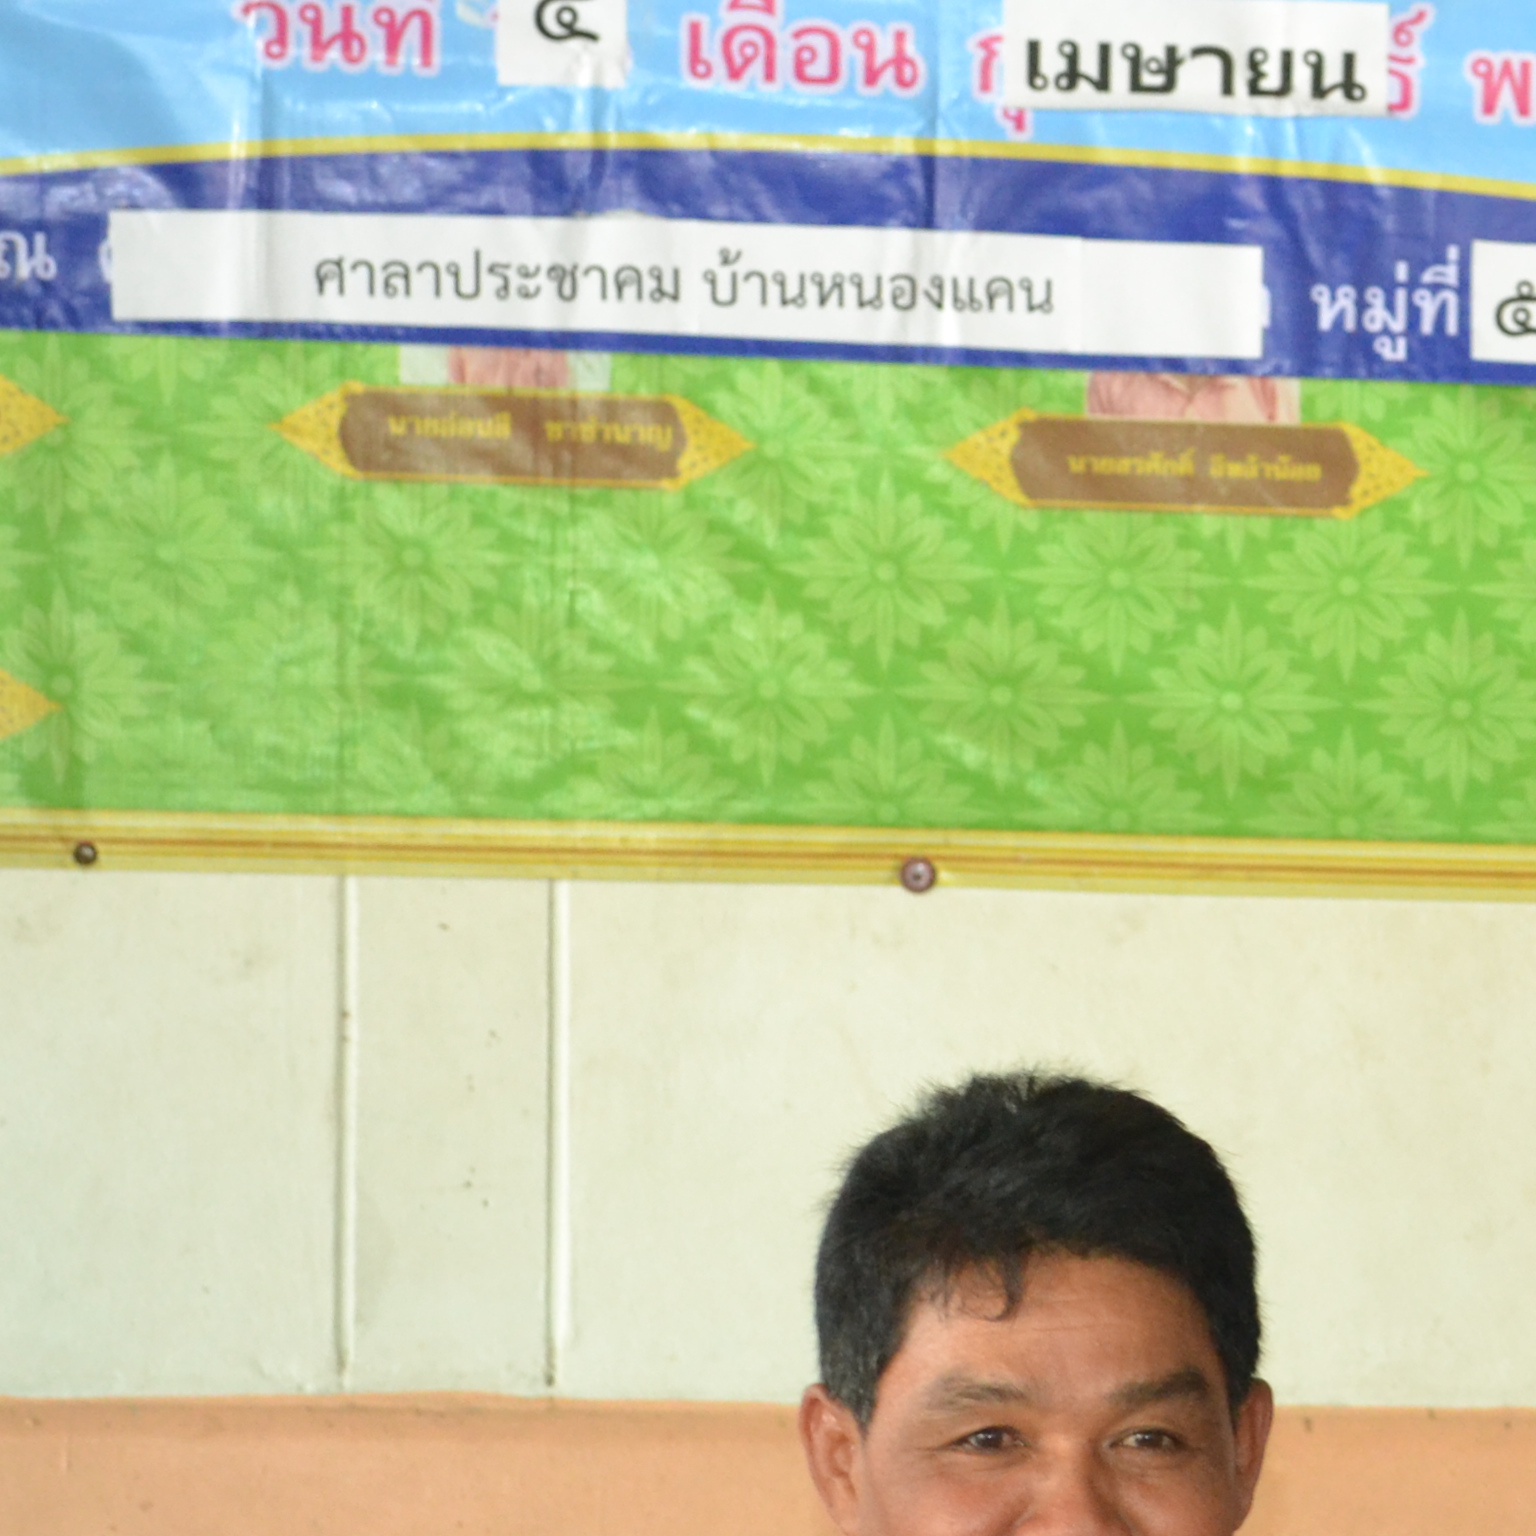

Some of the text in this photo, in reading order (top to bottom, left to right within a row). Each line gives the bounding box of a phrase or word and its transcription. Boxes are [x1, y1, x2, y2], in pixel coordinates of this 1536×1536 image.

[1026, 38, 1367, 102] เมษายน
[313, 250, 682, 304] ศาลาประชาคม
[704, 246, 1055, 315] บ้านหนองแคน
[1309, 243, 1461, 363] หมู่ที่
